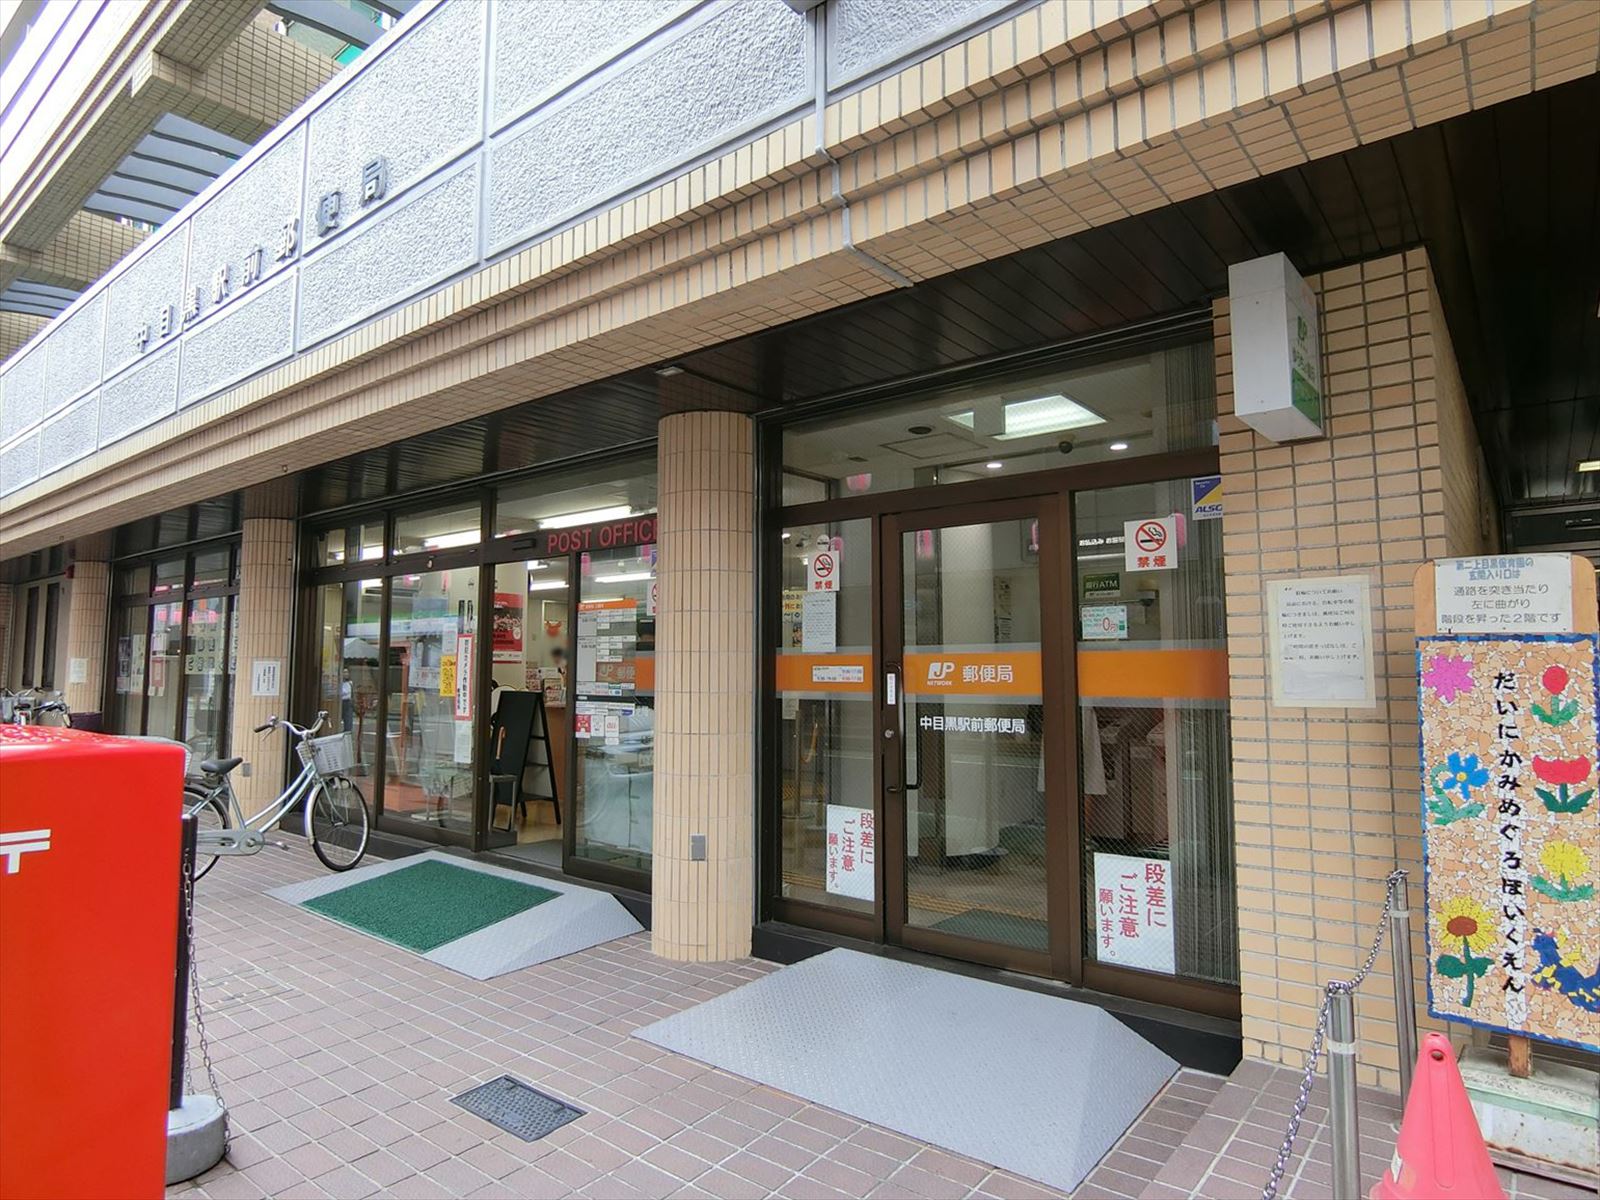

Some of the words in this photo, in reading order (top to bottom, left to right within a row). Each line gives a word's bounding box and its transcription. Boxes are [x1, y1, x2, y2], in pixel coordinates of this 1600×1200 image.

[1194, 504, 1222, 513] ALSO
[548, 527, 592, 554] POST
[1137, 555, 1167, 568] 禁煙
[815, 580, 833, 590] 禁煙
[1469, 569, 1521, 581] 玄関入り口は
[1454, 583, 1549, 597] 通路を突き当たり
[1472, 599, 1531, 610] 左に曲がり
[962, 664, 1013, 684] 郵便局
[920, 715, 1026, 734] 中目黒駅前郵便局
[860, 812, 874, 865] 段差に
[1494, 671, 1525, 995] だいにかみめぐろほいくえん
[841, 819, 856, 872] ご注意
[1119, 872, 1140, 939] ご注意
[1145, 863, 1167, 928] 段差に
[1099, 888, 1116, 957] 願います。
